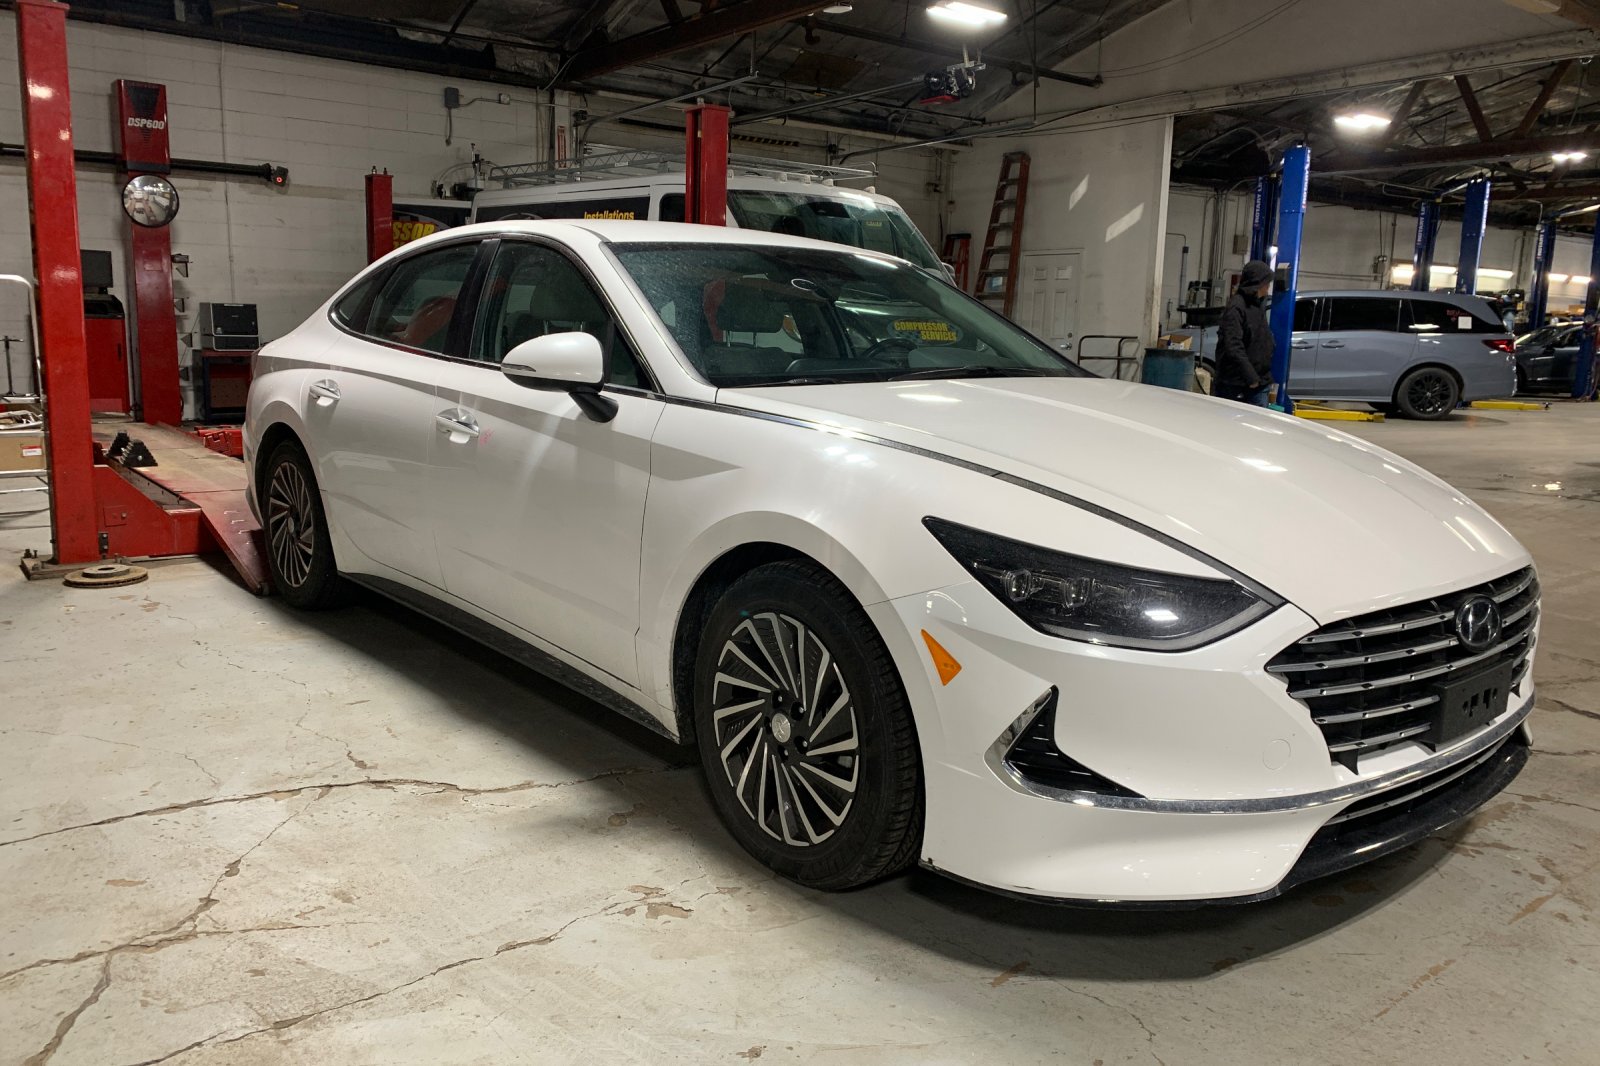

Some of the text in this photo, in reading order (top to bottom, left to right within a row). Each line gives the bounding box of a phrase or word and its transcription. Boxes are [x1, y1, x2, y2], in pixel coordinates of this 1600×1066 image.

[127, 117, 165, 130] DSP600
[583, 209, 635, 220] Installations
[894, 321, 948, 332] COMPRESSOR
